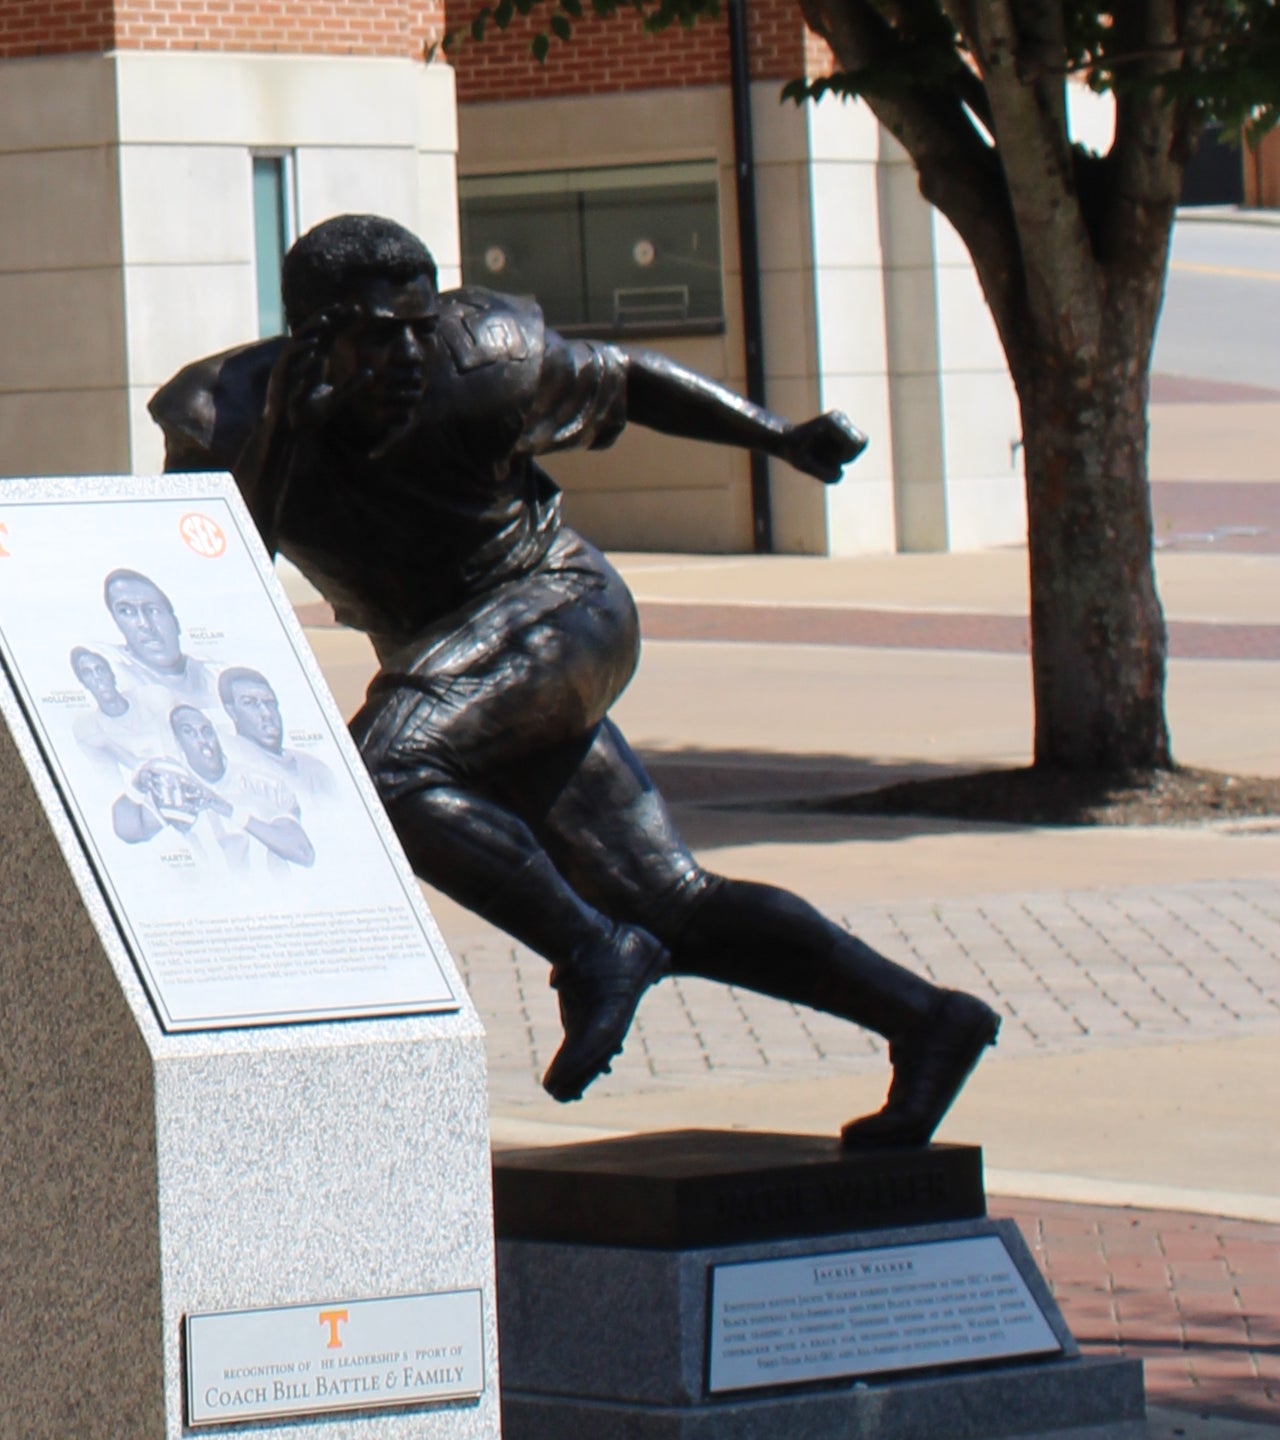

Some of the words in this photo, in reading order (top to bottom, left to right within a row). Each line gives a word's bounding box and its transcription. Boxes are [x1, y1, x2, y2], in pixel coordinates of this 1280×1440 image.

[181, 514, 225, 557] SEC
[860, 1261, 913, 1274] WALKER
[319, 1310, 348, 1349] T
[223, 1362, 295, 1380] RECOGNITION
[298, 1360, 312, 1372] OF
[338, 1351, 400, 1368] LEADERSHIP
[450, 1345, 463, 1356] OF
[205, 1387, 267, 1408] COACH
[273, 1379, 311, 1401] BILL
[315, 1374, 380, 1397] BATTLE
[385, 1370, 398, 1389] &
[403, 1365, 464, 1388] FAMILY
